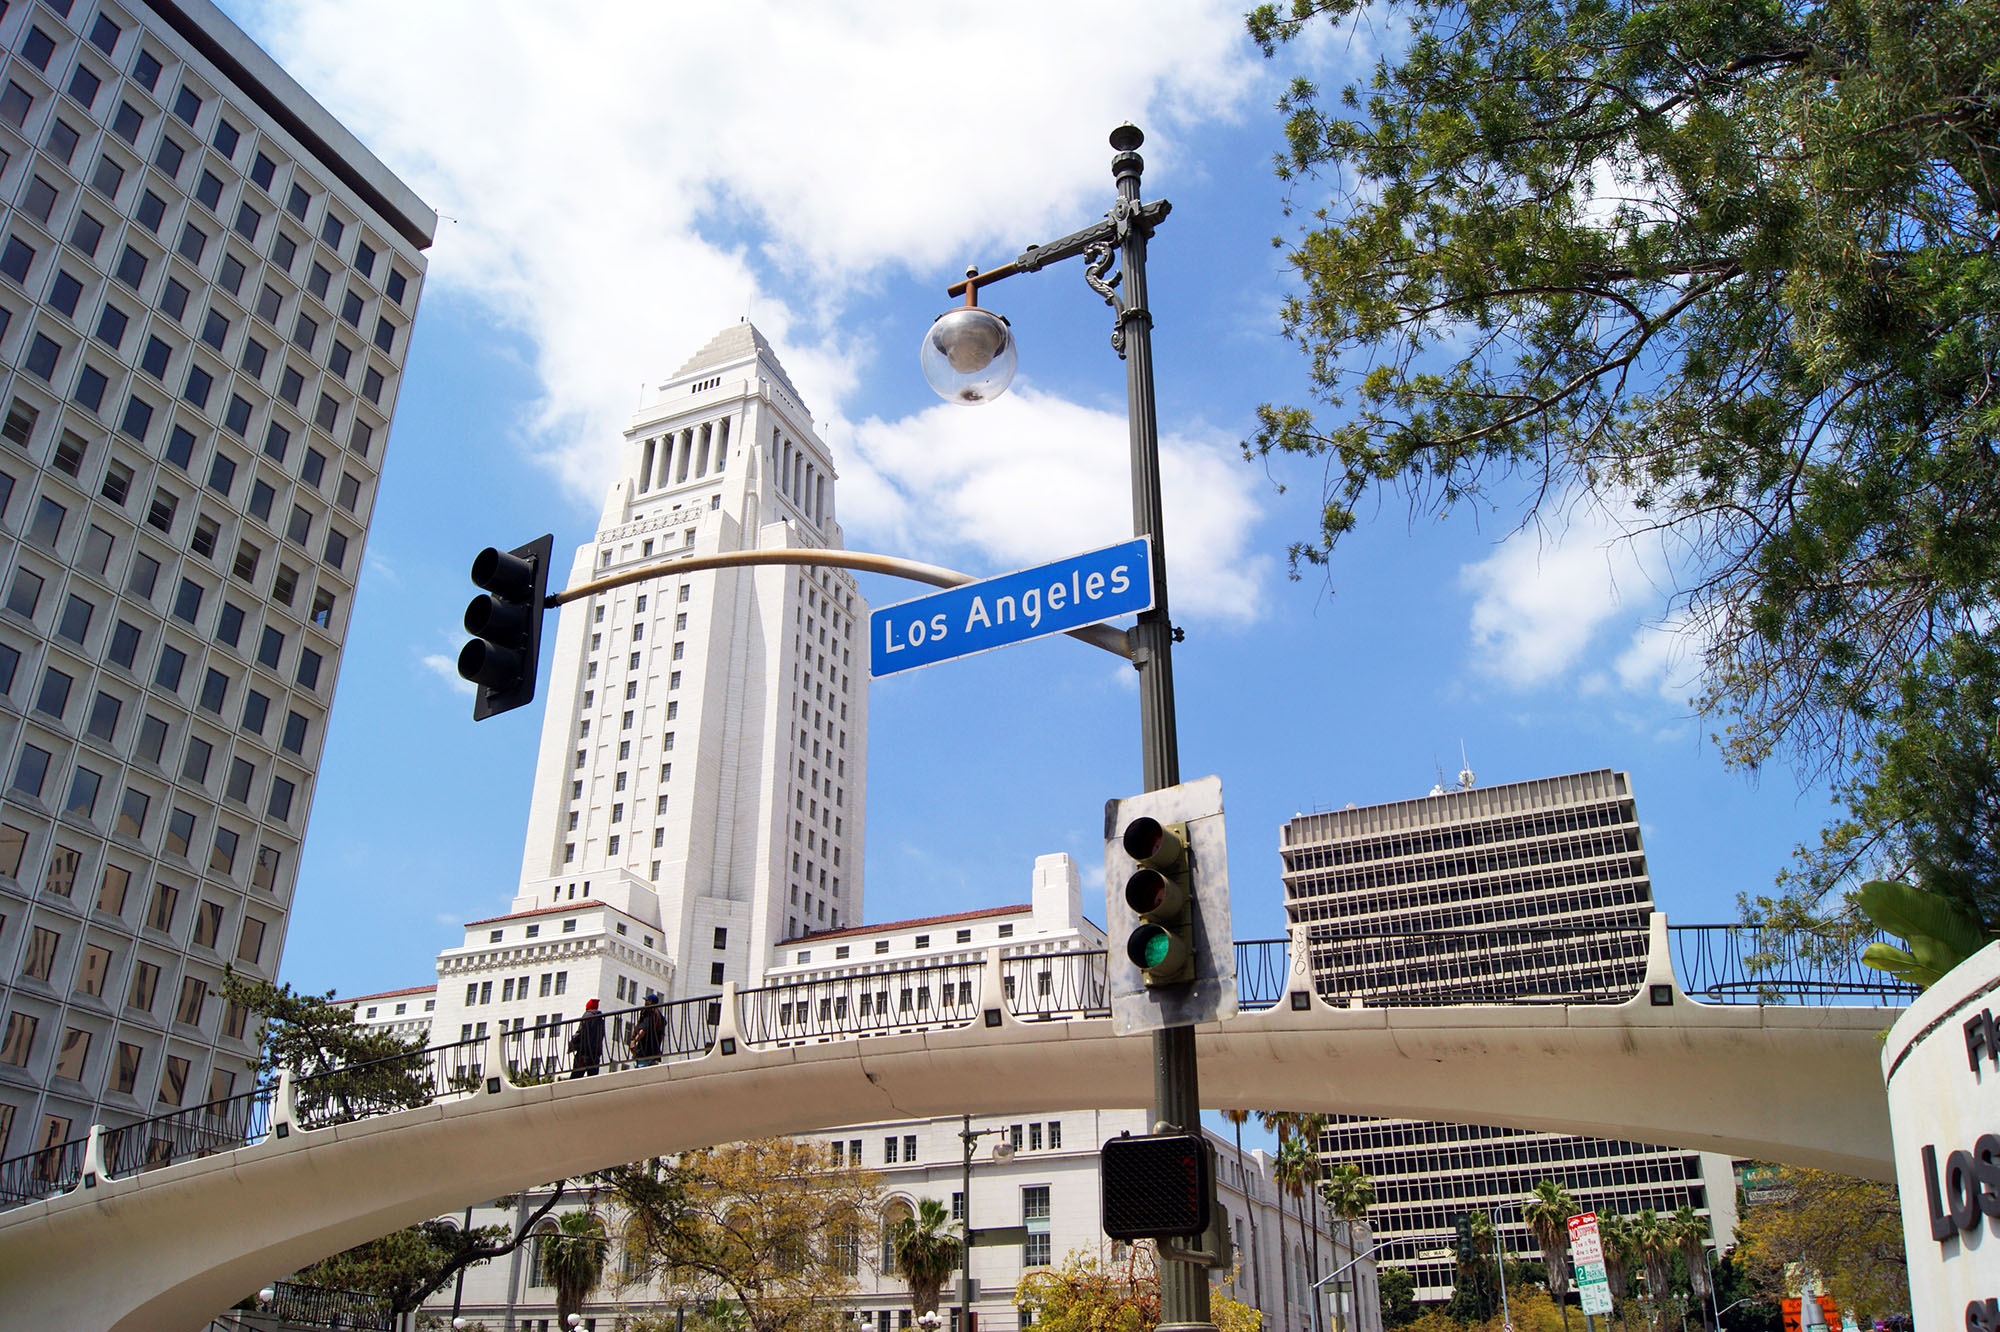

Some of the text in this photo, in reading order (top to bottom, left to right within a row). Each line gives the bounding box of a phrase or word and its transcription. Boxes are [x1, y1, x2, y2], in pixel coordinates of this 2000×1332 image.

[885, 565, 1131, 654] Los Angeles
[1921, 1133, 2000, 1241] Los
[1577, 1267, 1584, 1279] 2
